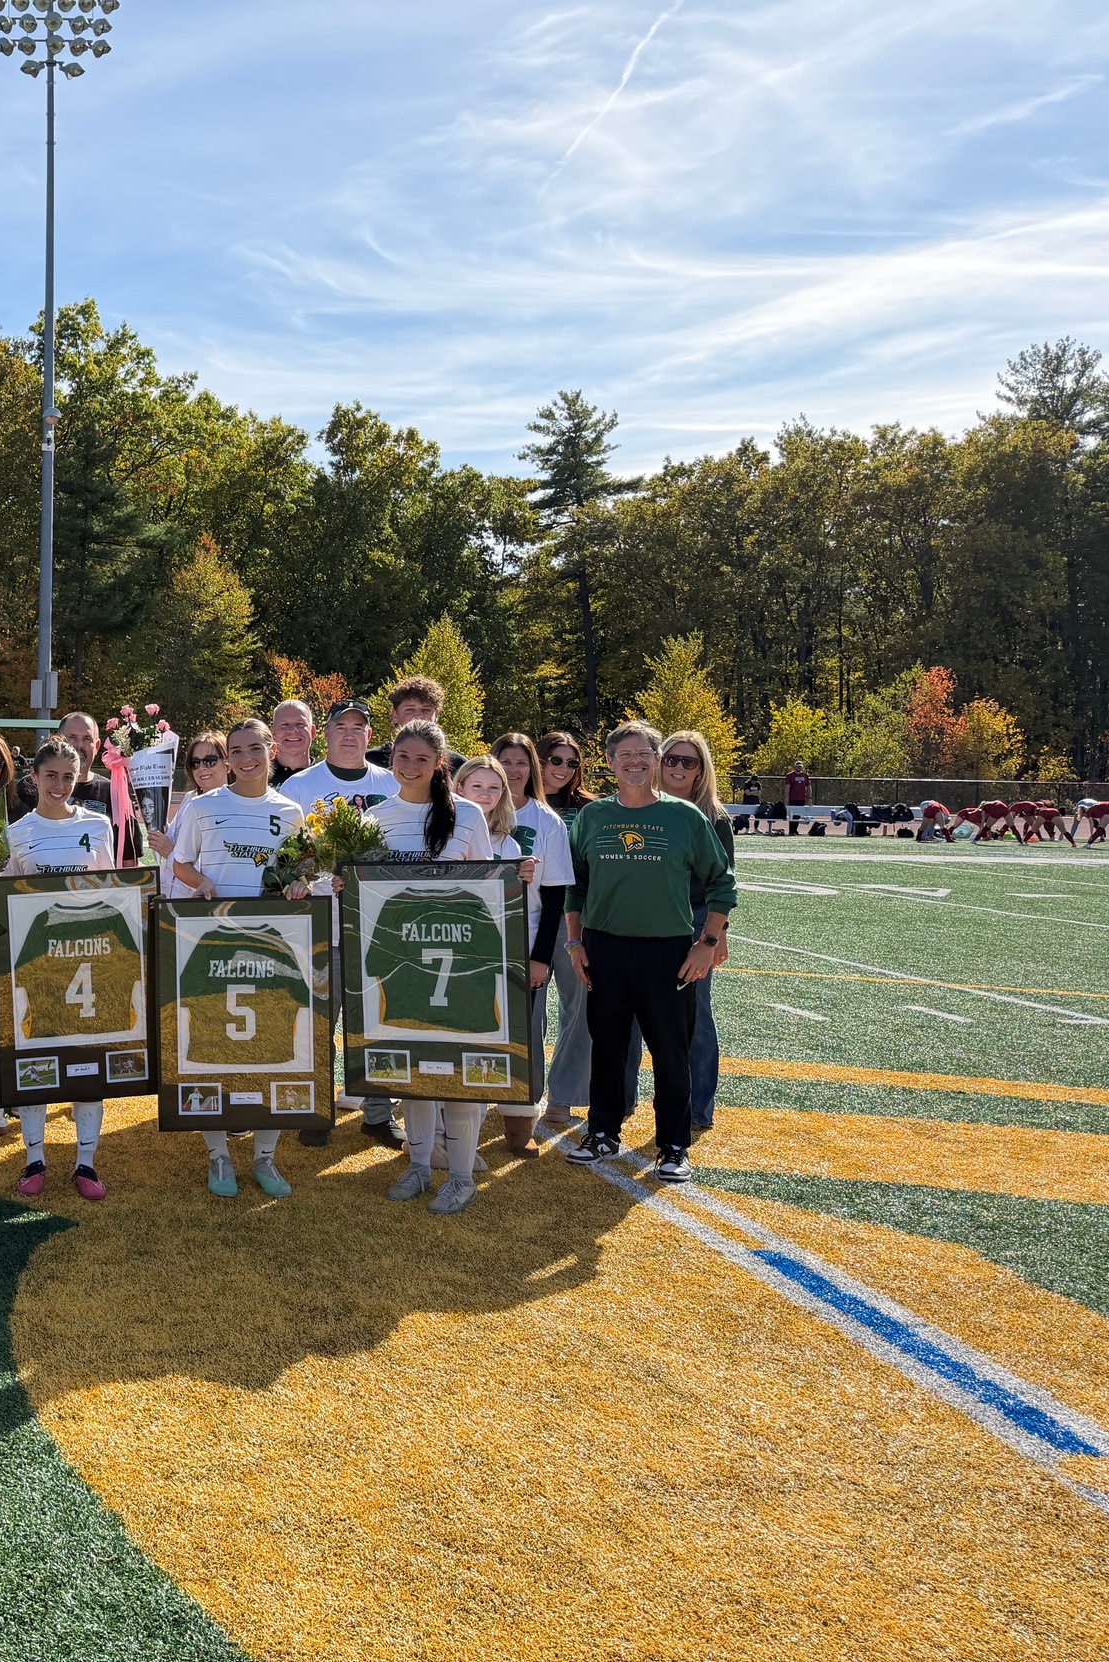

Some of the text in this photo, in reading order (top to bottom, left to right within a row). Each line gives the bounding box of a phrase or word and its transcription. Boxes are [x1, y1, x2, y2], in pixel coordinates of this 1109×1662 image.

[269, 814, 282, 836] 5
[602, 823, 664, 832] FITCHBURG STATE
[78, 832, 91, 853] 4
[224, 842, 275, 855] FITCHBURG
[231, 851, 257, 859] STATE
[36, 863, 89, 874] FITCHBURG
[401, 923, 472, 943] FALCONS
[47, 937, 111, 958] FALCONS
[208, 959, 276, 979] FALCONS
[421, 948, 453, 1007] 7
[65, 962, 96, 1018] 4
[225, 984, 256, 1041] 5
